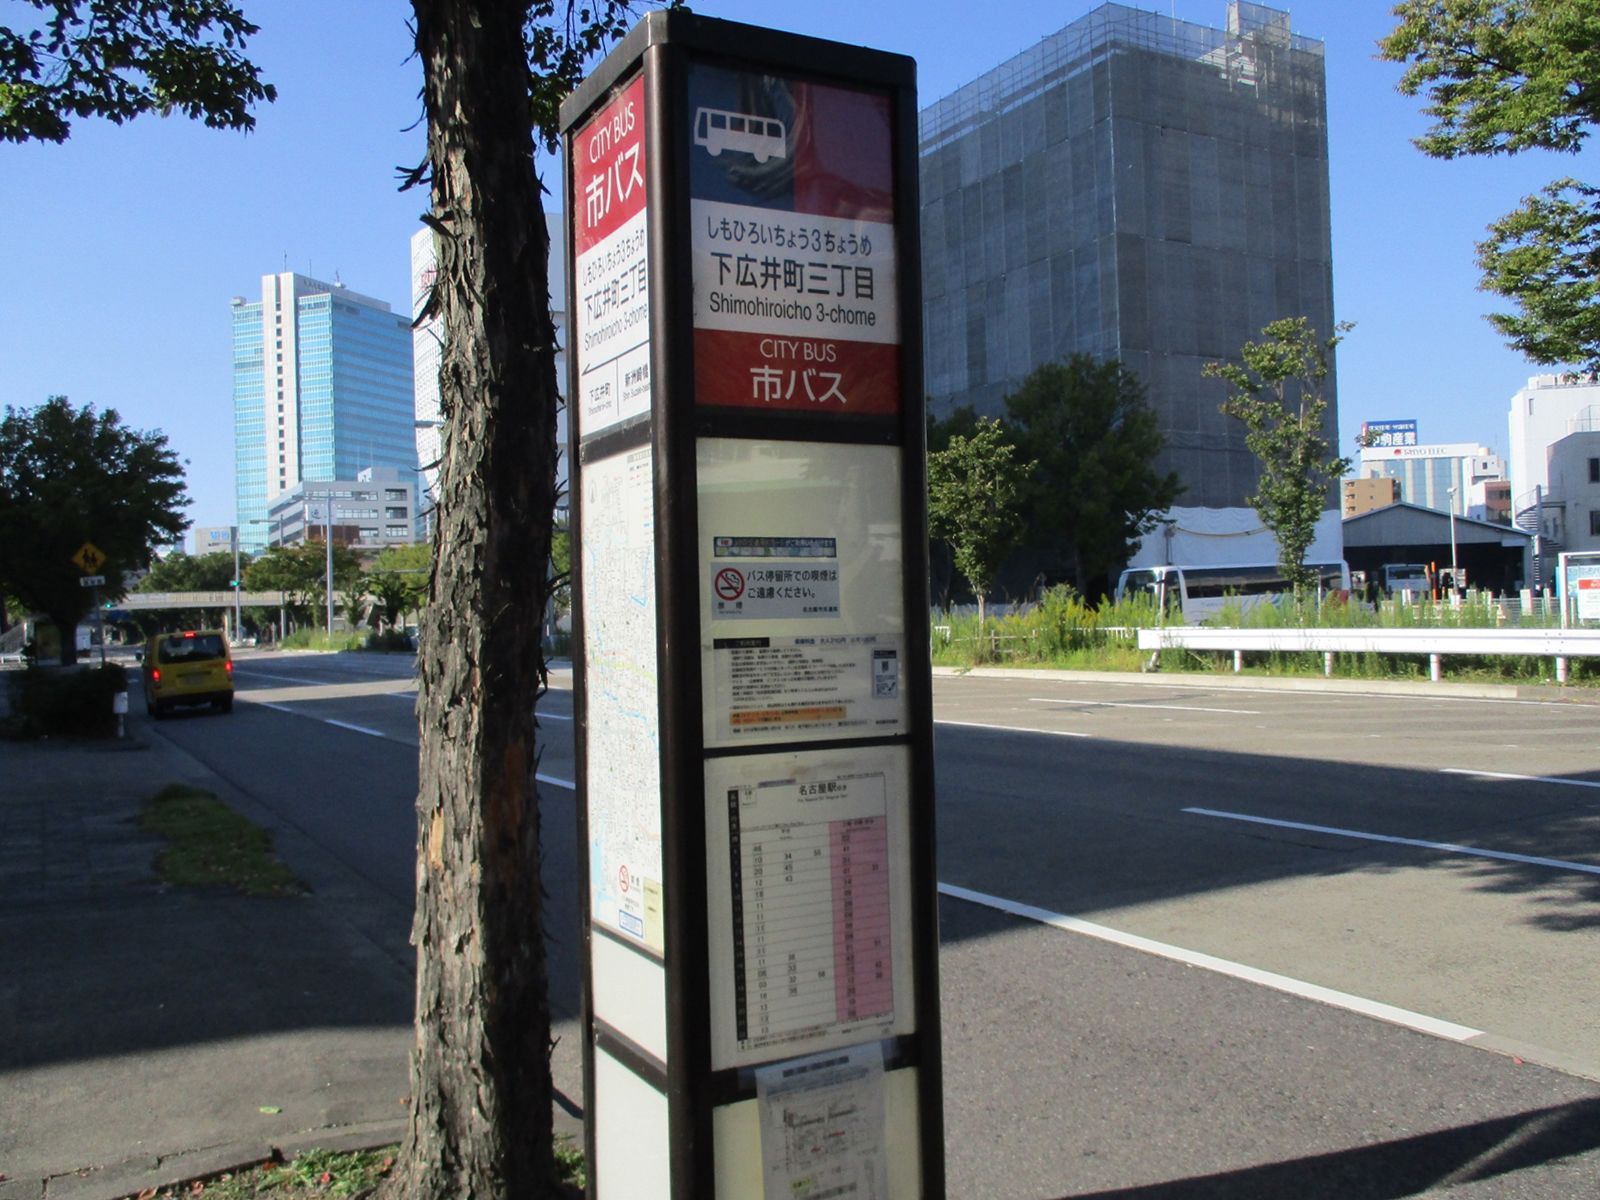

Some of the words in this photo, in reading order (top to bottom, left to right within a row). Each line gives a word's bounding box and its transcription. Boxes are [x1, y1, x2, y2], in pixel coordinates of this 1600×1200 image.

[589, 121, 612, 164] CITY
[614, 101, 635, 144] BUS
[585, 141, 644, 228] 市バス
[708, 215, 872, 257] しもひろいちょう3ちょうめ
[584, 257, 647, 326] 下広井町三丁目
[710, 252, 874, 300] 下広井町三丁目
[710, 291, 812, 322] Shimohiroicho
[816, 302, 876, 326] 3-chome
[760, 338, 799, 359] CITY
[803, 342, 837, 363] BUS
[750, 365, 848, 404] 市バス
